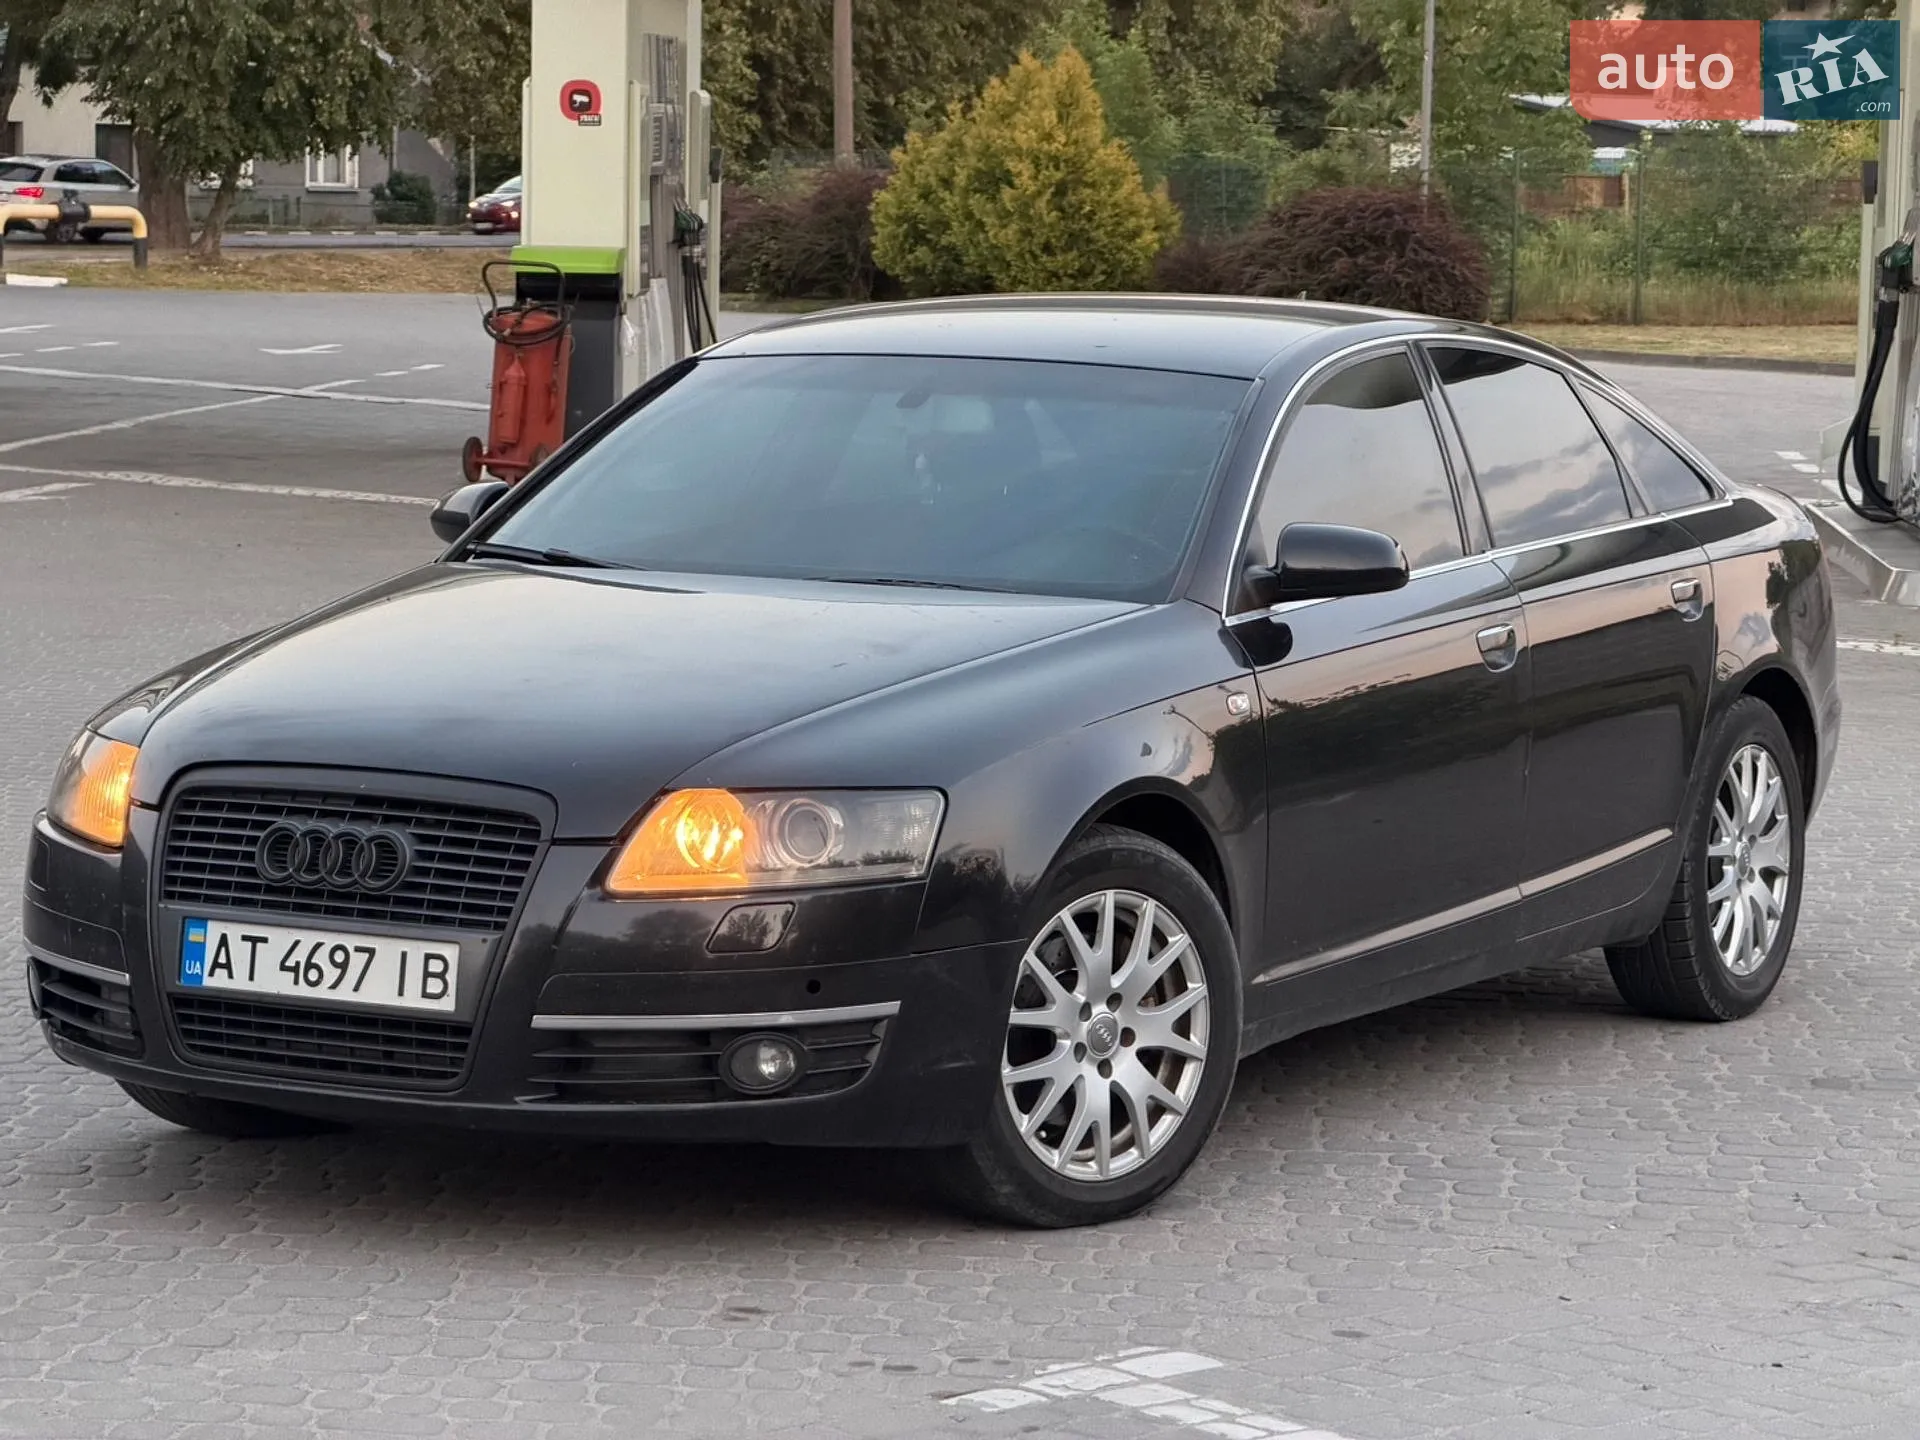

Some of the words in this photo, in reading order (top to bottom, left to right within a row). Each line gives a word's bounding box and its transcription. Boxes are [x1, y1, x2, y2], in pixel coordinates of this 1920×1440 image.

[185, 960, 202, 975] UA
[208, 933, 268, 981] AT
[279, 939, 376, 992] 4697
[397, 950, 449, 1000] IB
